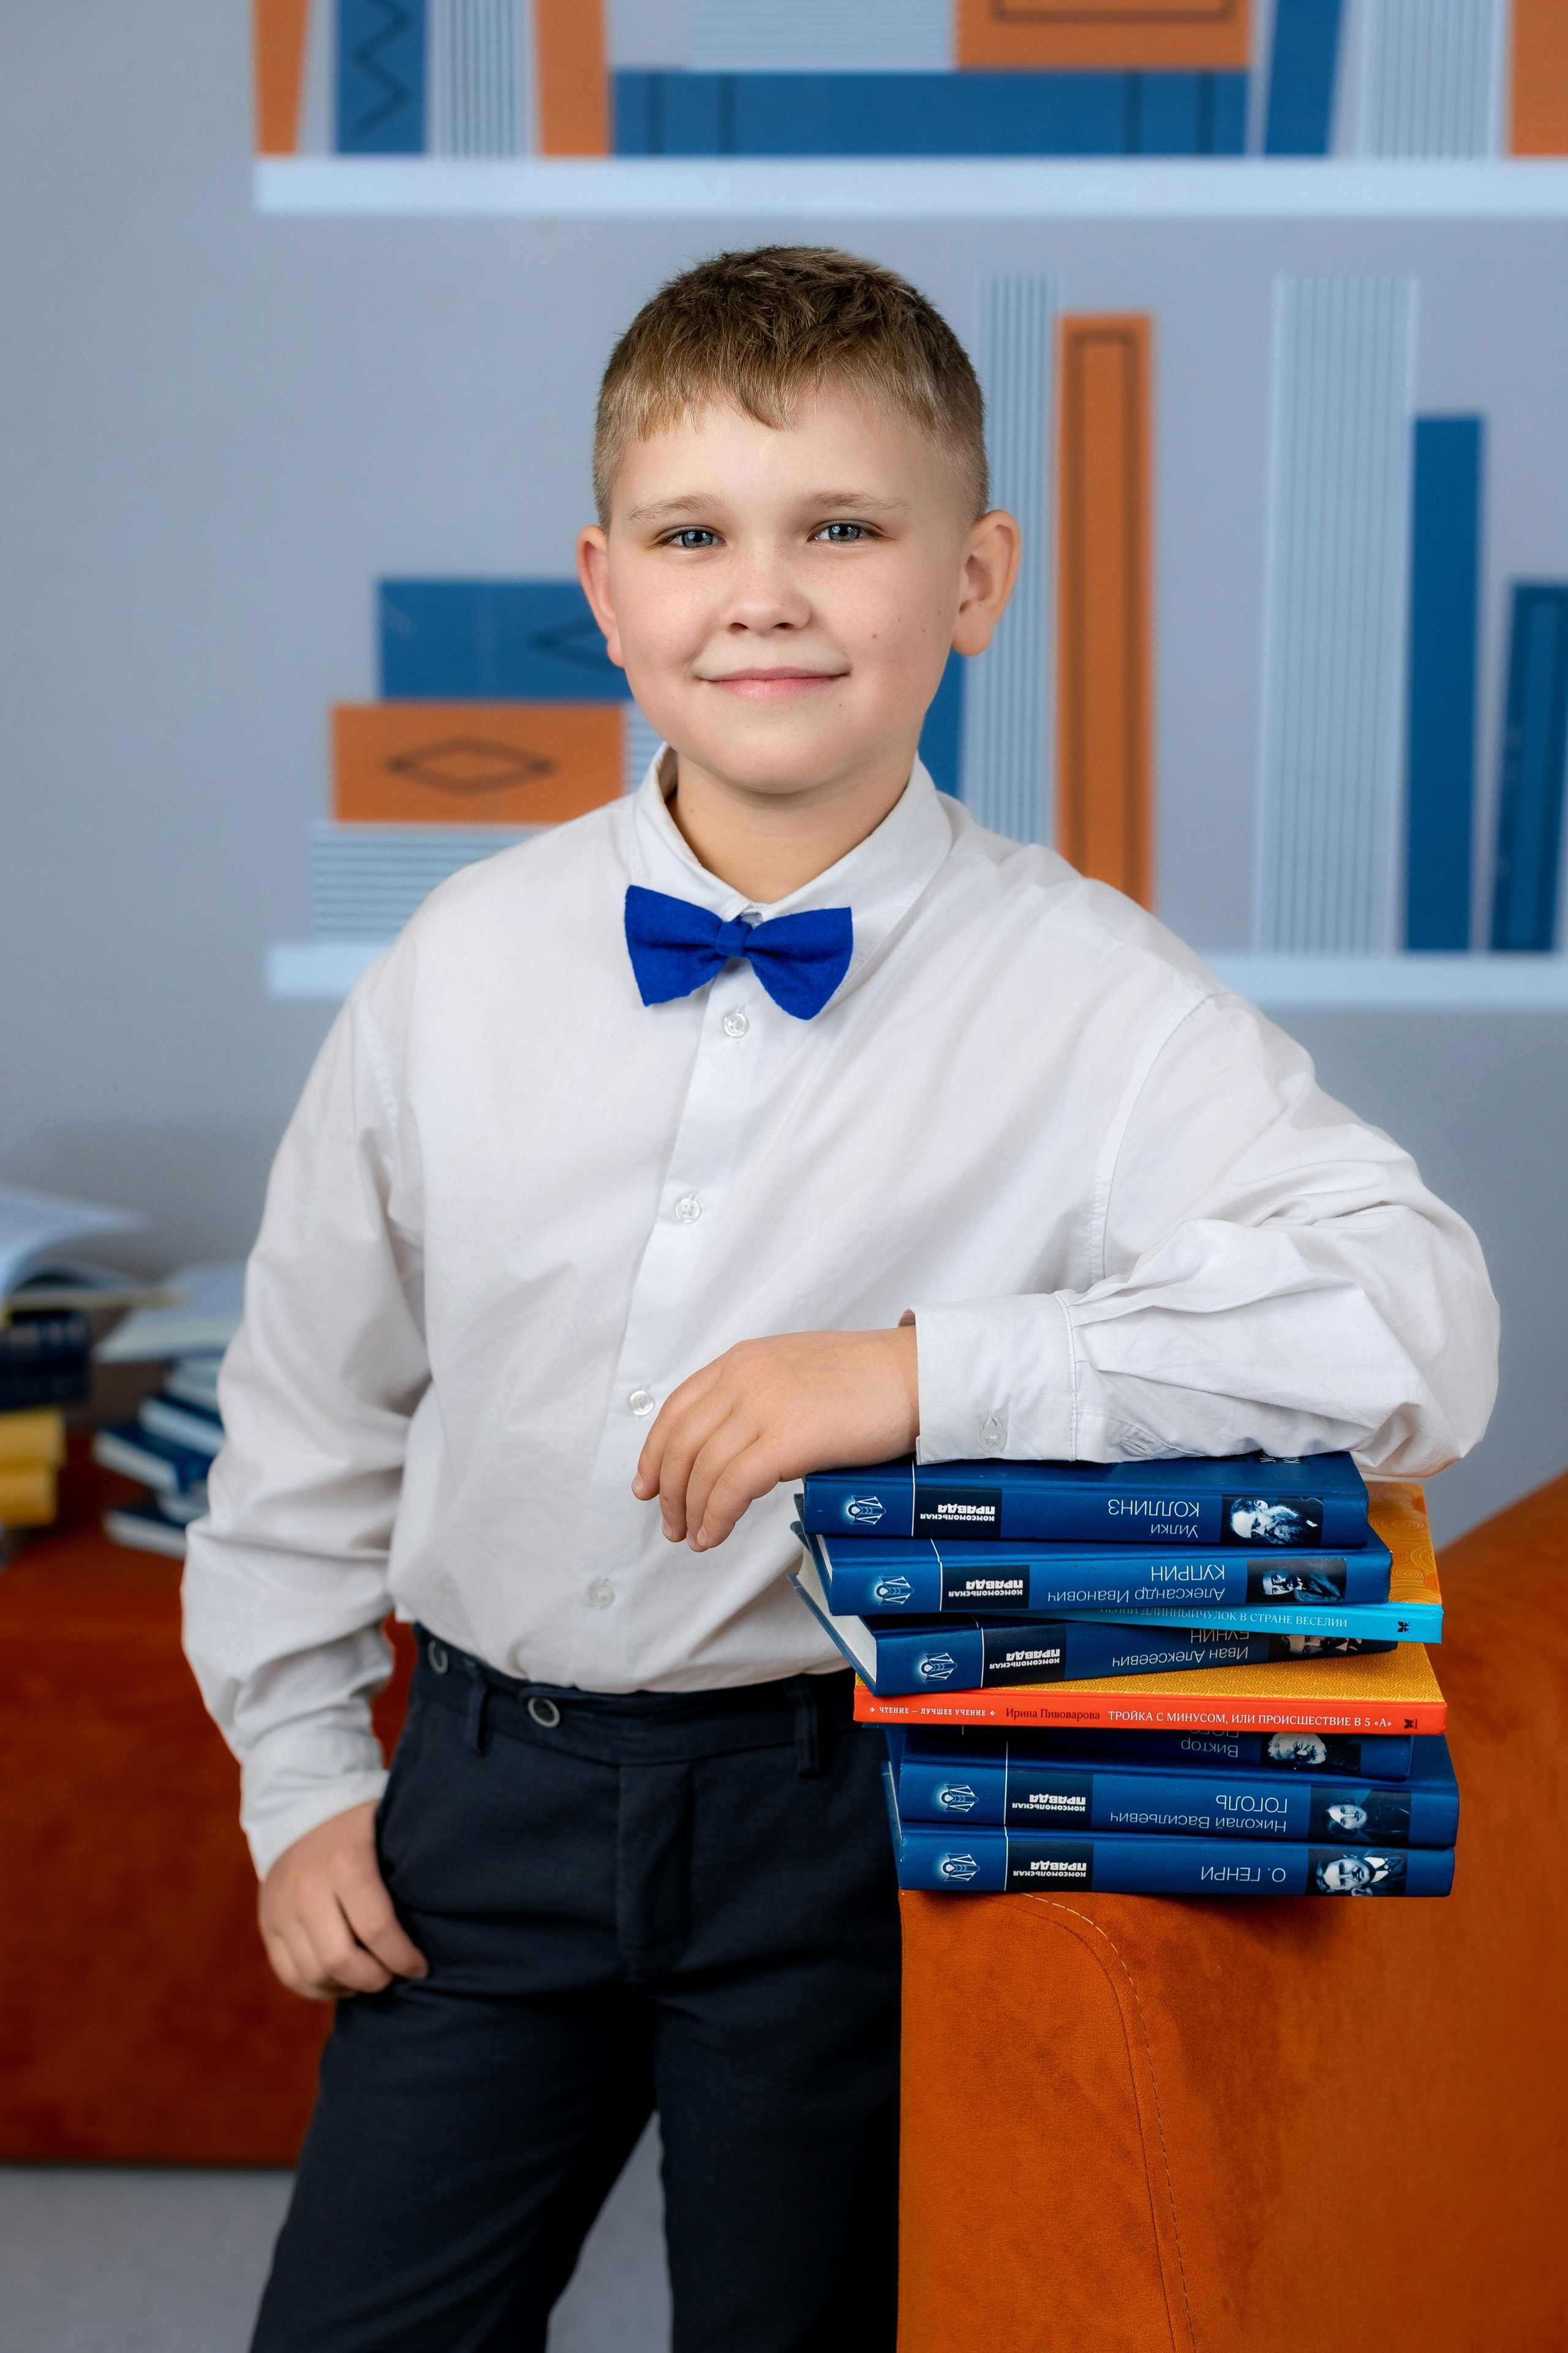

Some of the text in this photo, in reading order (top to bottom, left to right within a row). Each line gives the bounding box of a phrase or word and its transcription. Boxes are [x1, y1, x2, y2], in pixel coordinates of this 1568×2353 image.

[938, 1503, 995, 1514] ПРАВДА
[1108, 1499, 1199, 1517] КОЛЛИНЗ
[1151, 1524, 1199, 1538] Уилки
[1151, 1565, 1225, 1581] КУПРИН
[966, 1579, 1023, 1590] ПРАВДА
[1047, 1587, 1226, 1603] Александр Иванович
[1140, 1607, 1237, 1620] ДЛИННЫЙЧУЛОК
[1240, 1612, 1247, 1621] В
[1250, 1613, 1292, 1624] СТРАНЕ
[1295, 1616, 1348, 1627] ВЕСЕЛИИ
[1006, 1649, 1060, 1661] ПРАВДА
[1112, 1646, 1248, 1667] Иван Алексеевич
[989, 1658, 1060, 1669] КОМСОМОЛЬСКАЯ
[1006, 1708, 1100, 1721] Ирина Пивоварова
[1108, 1710, 1392, 1727] ТРОЙКА С МИНУСОМ, ИЛИ ПРОИСШЕСТВИЕ В 5 «А»
[1181, 1737, 1238, 1758] Виктор
[1012, 1802, 1085, 1811] КОМСОМОЛЬСКАЯ
[1029, 1794, 1086, 1805] ПРАВДА
[1216, 1795, 1287, 1813] ГОГОЛЬ
[1110, 1812, 1286, 1832] Николай Васильевич
[1030, 1860, 1087, 1871] ПРАВДА
[1201, 1866, 1286, 1883] О. ГЕНРИ
